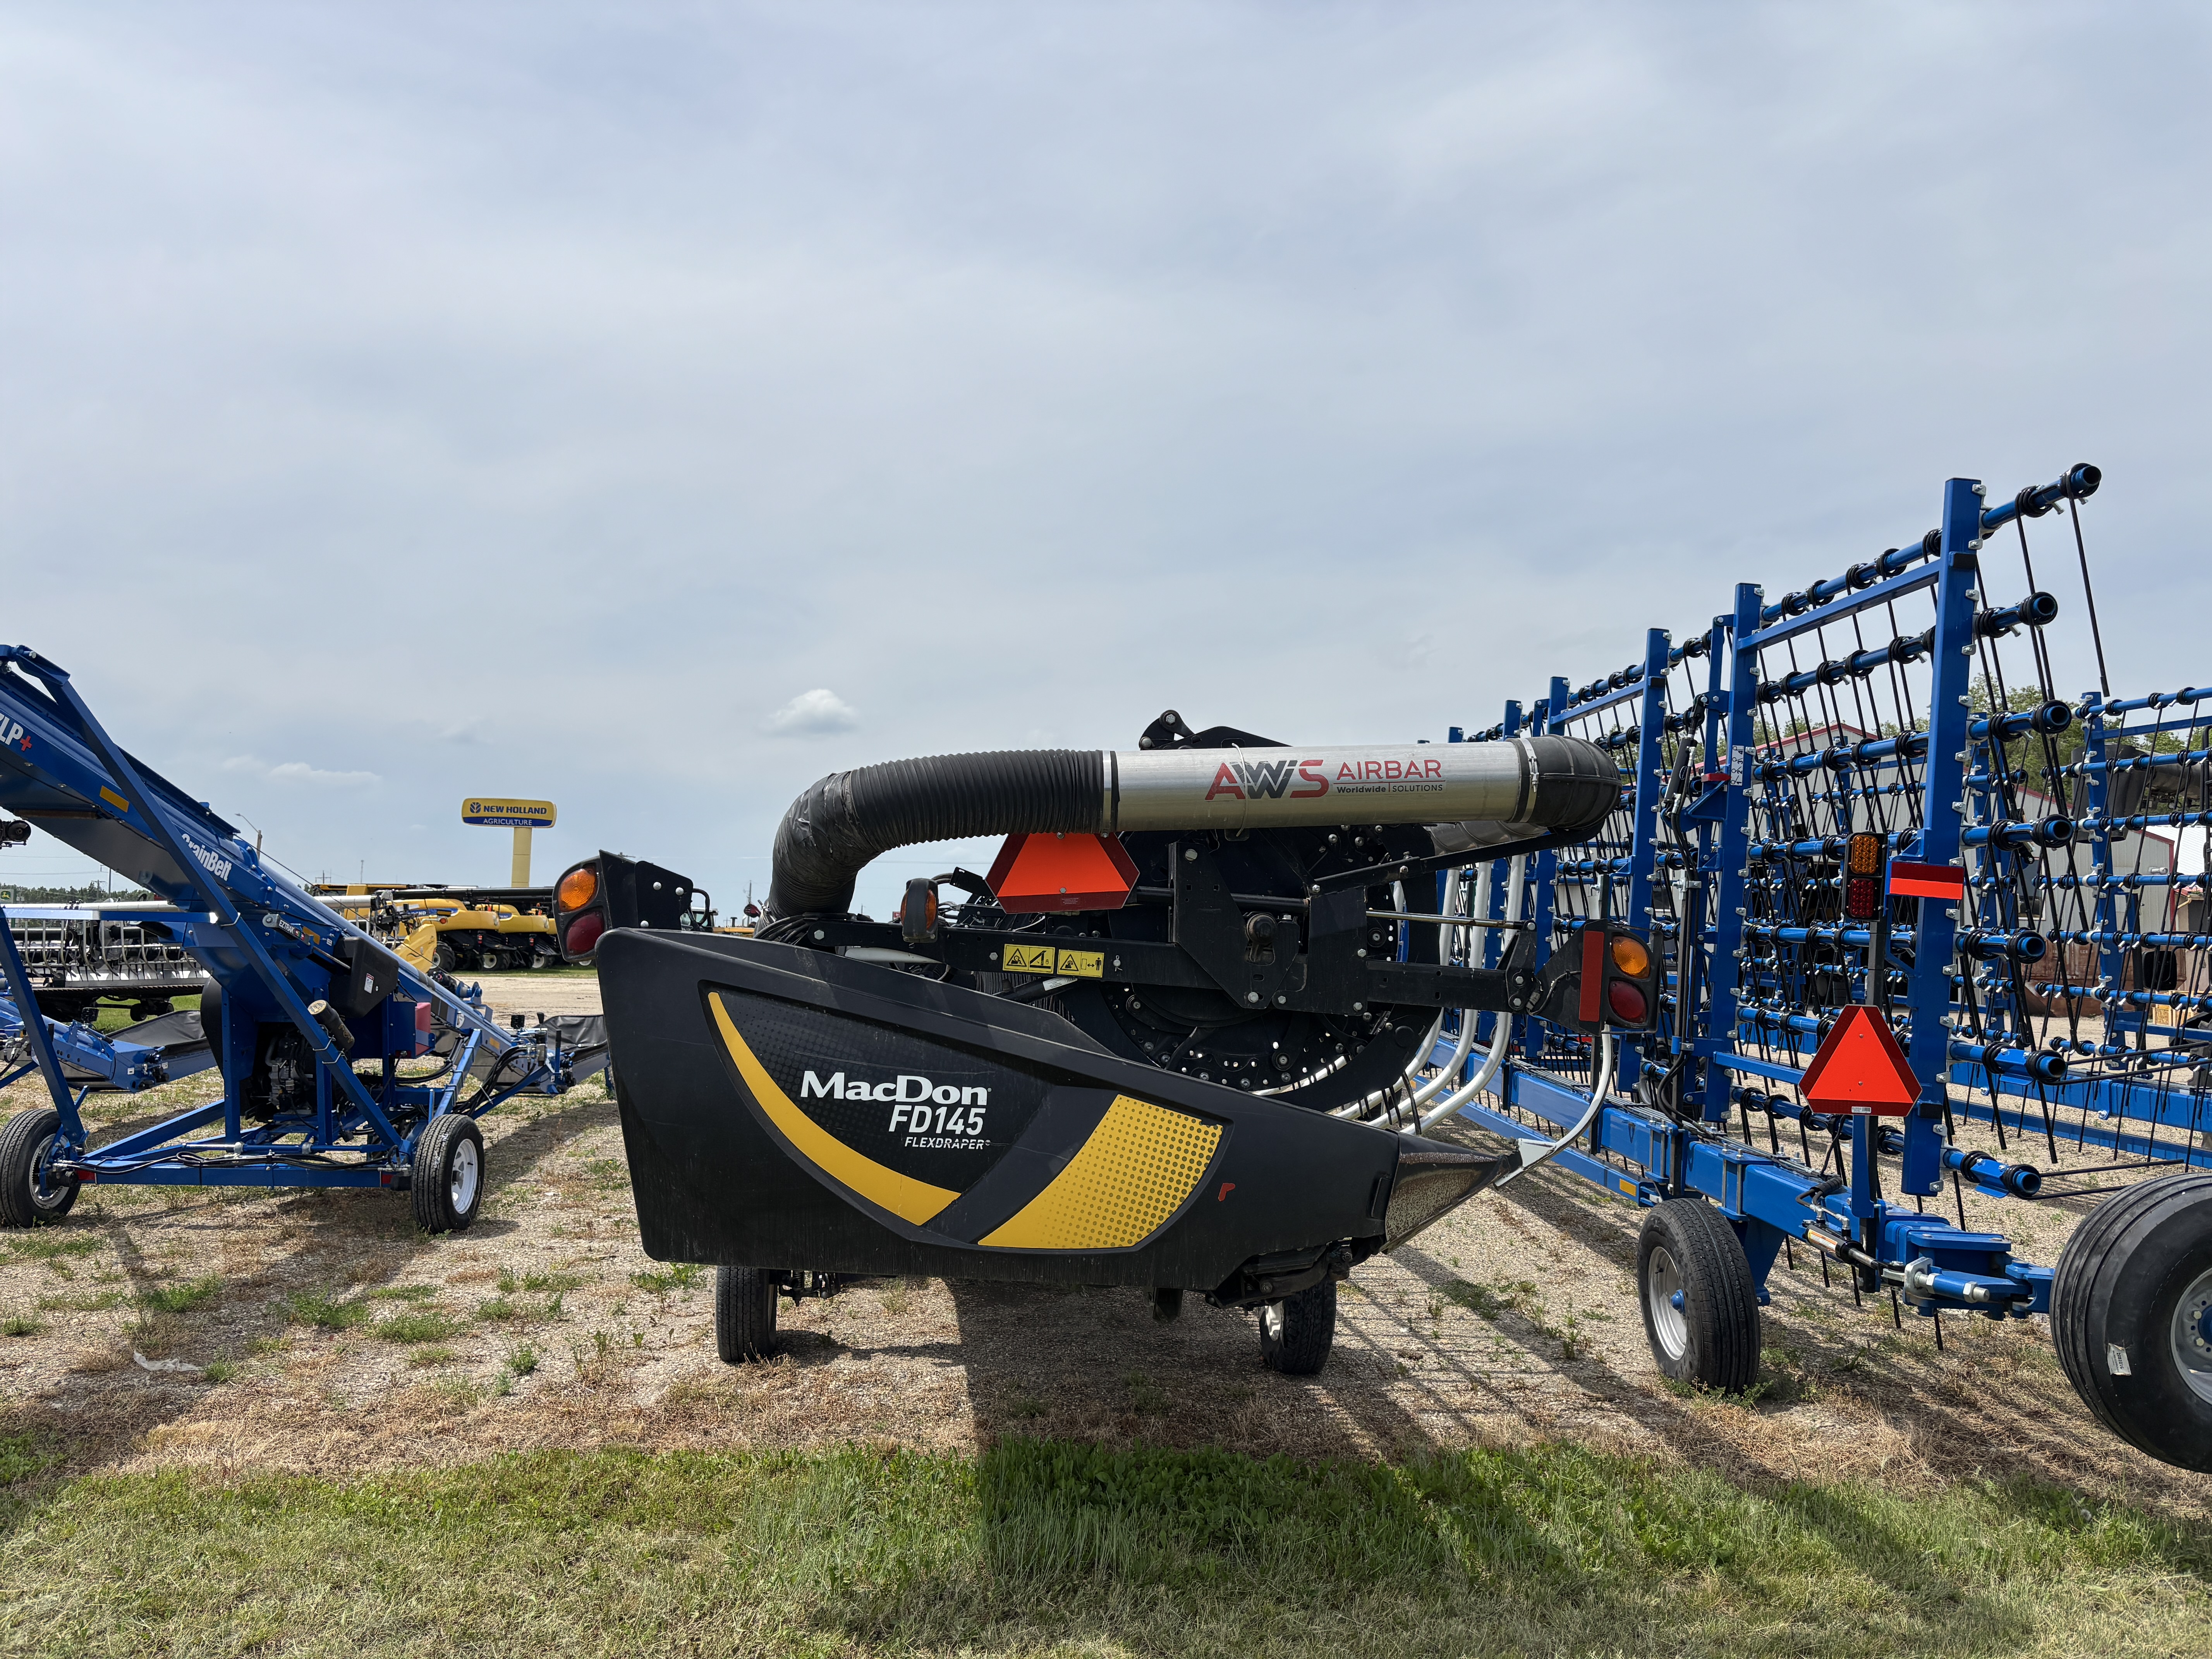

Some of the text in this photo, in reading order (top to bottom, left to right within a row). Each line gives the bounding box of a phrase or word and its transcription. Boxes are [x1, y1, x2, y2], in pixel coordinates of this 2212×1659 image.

[1336, 759, 1442, 780] AIRBAR
[1205, 759, 1329, 800] AWS
[1337, 785, 1443, 793] Worldwide SOLUTIONS
[506, 806, 547, 814] HOLLAND
[278, 919, 295, 934] EZTRAK
[889, 1105, 986, 1135] FD145
